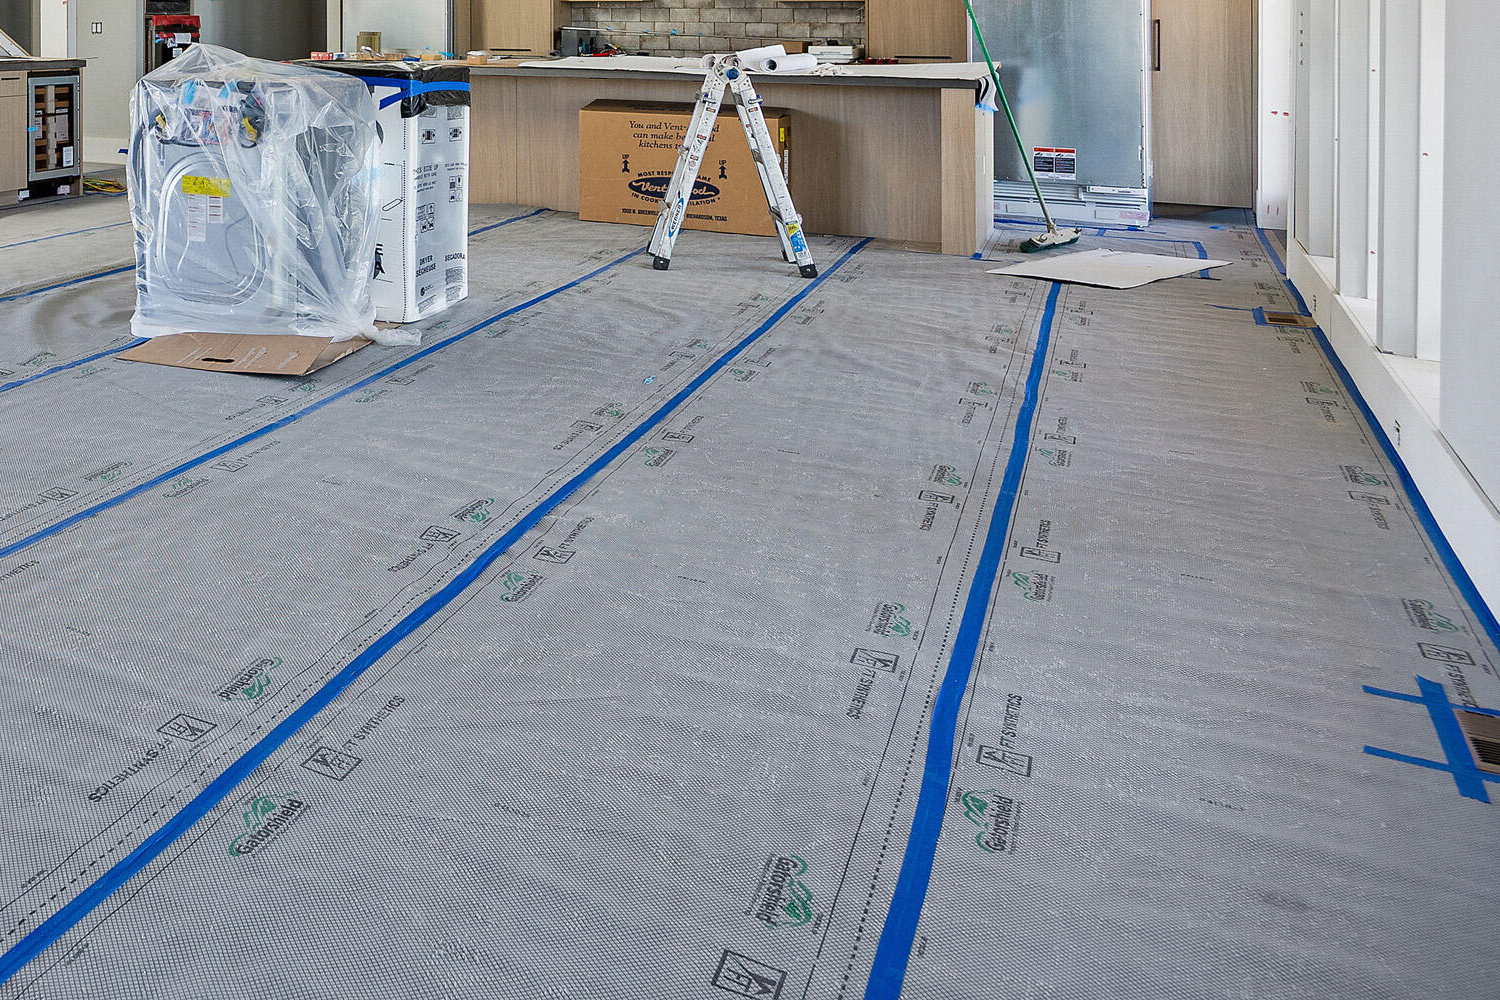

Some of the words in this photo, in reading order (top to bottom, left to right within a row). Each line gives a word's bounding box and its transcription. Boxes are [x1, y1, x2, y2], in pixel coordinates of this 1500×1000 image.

[629, 121, 644, 129] You
[646, 122, 662, 130] and
[639, 140, 673, 149] kitchens
[651, 132, 674, 140] make
[671, 204, 682, 230] WERNER
[420, 255, 433, 266] DRYER
[218, 657, 275, 701] Gatorshield
[352, 694, 406, 742] SYNTHETICS
[1002, 693, 1023, 739] SYNTHETICS
[87, 748, 160, 803] SYNTHETICS
[235, 798, 305, 856] Gatorshield
[984, 793, 1014, 852] Gatorshield
[755, 854, 799, 928] Gatorshield
